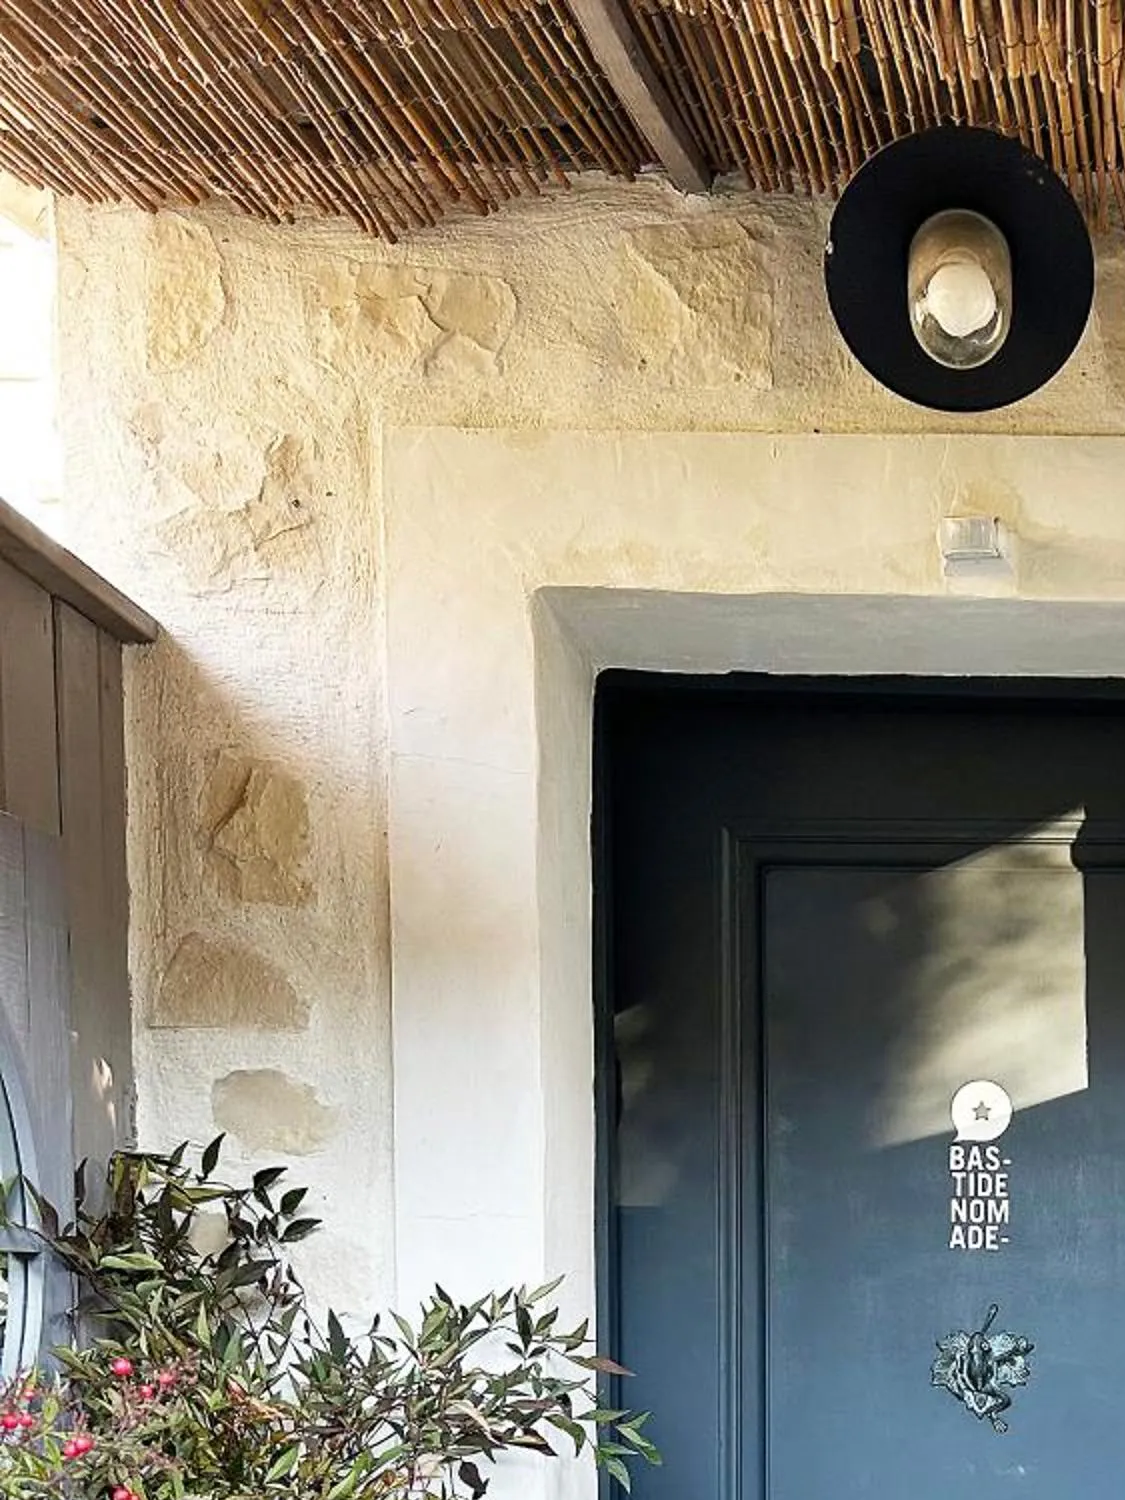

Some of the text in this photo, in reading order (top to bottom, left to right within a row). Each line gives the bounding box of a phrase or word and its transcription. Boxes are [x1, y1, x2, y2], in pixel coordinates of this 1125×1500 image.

[949, 1145, 1012, 1171] BAS-
[951, 1172, 1009, 1197] TIDE
[951, 1199, 1009, 1224] NOM
[949, 1226, 1009, 1250] ADE-
